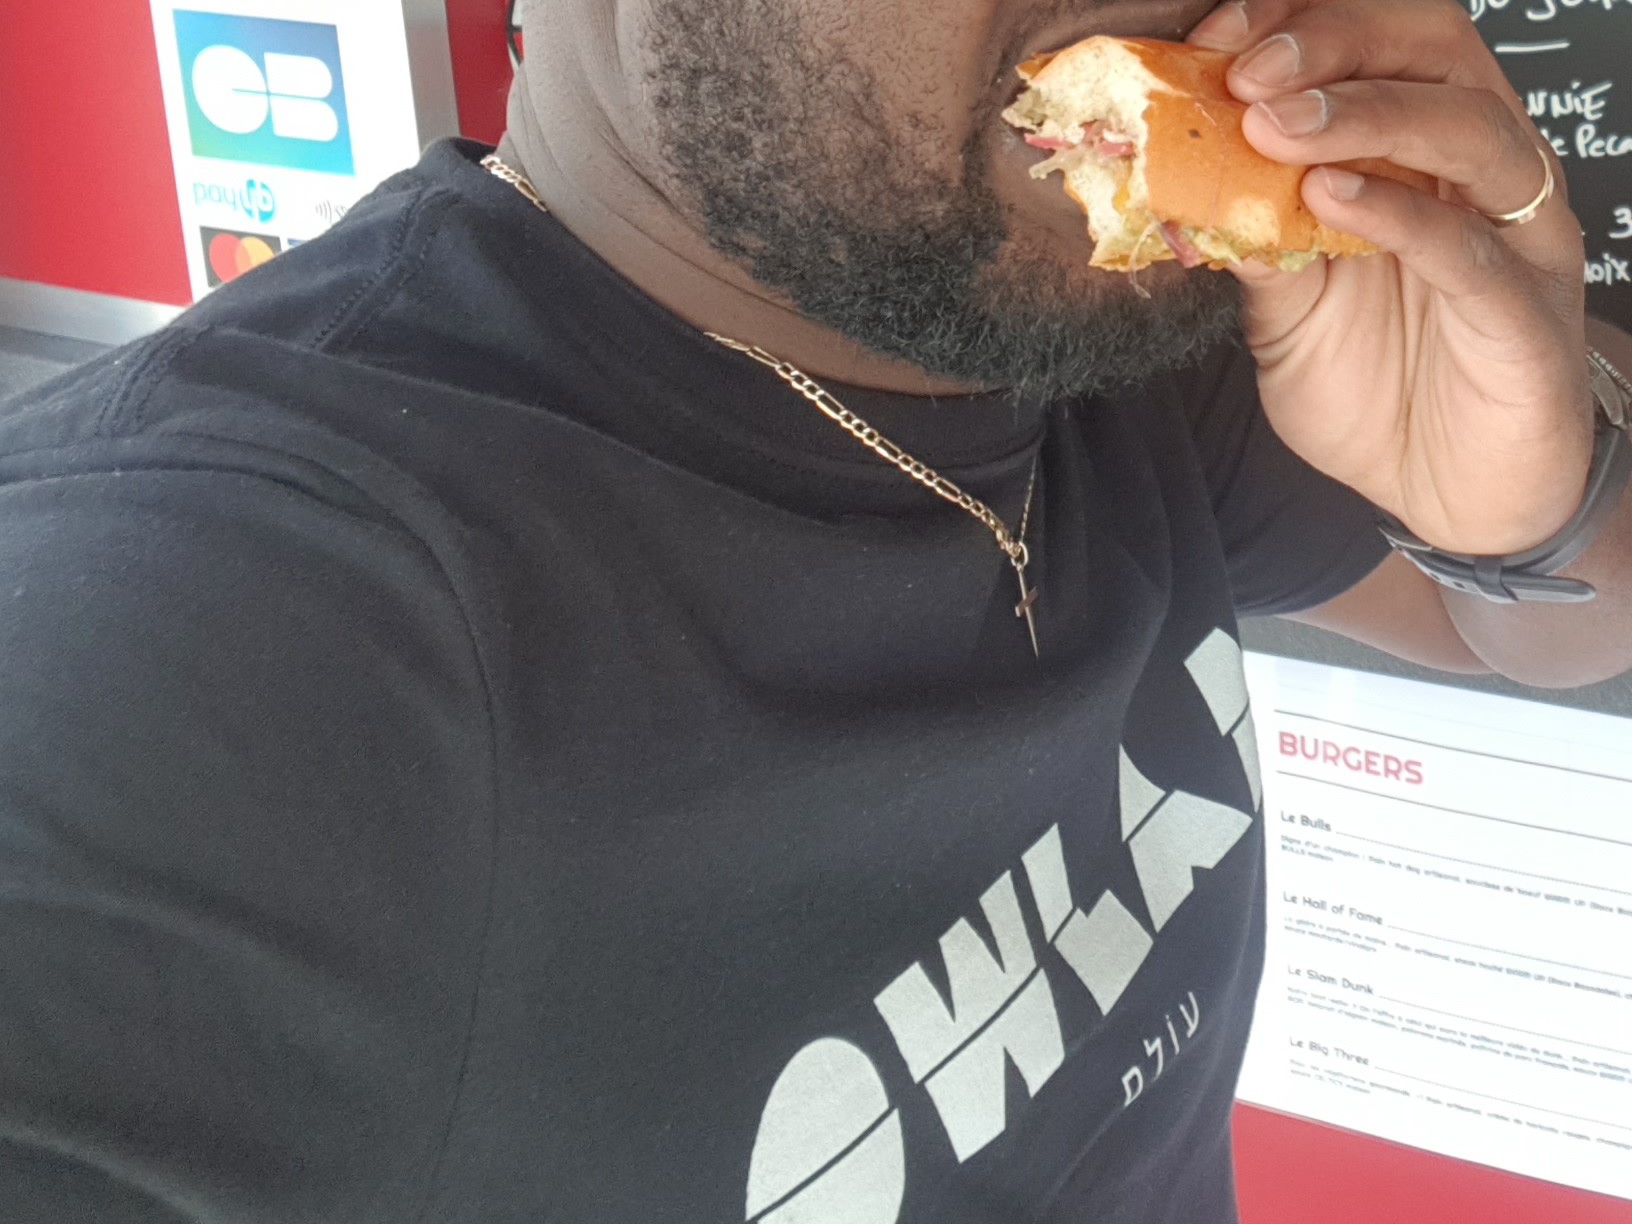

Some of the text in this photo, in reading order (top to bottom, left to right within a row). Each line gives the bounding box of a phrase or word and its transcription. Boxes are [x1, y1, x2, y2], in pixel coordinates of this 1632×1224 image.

[1278, 730, 1424, 785] BURGERS
[1280, 810, 1296, 824] Le
[1300, 813, 1332, 832] Bulls
[1282, 890, 1298, 904] Le
[1302, 895, 1328, 912] Hall
[1331, 903, 1346, 915] of
[1348, 906, 1384, 926] Fame
[1287, 964, 1302, 977] Le
[1306, 968, 1338, 986] Slam
[1341, 976, 1375, 996] Dunk
[1288, 1035, 1304, 1049] Le
[1308, 1040, 1330, 1057] Big
[1333, 1046, 1370, 1067] Three
